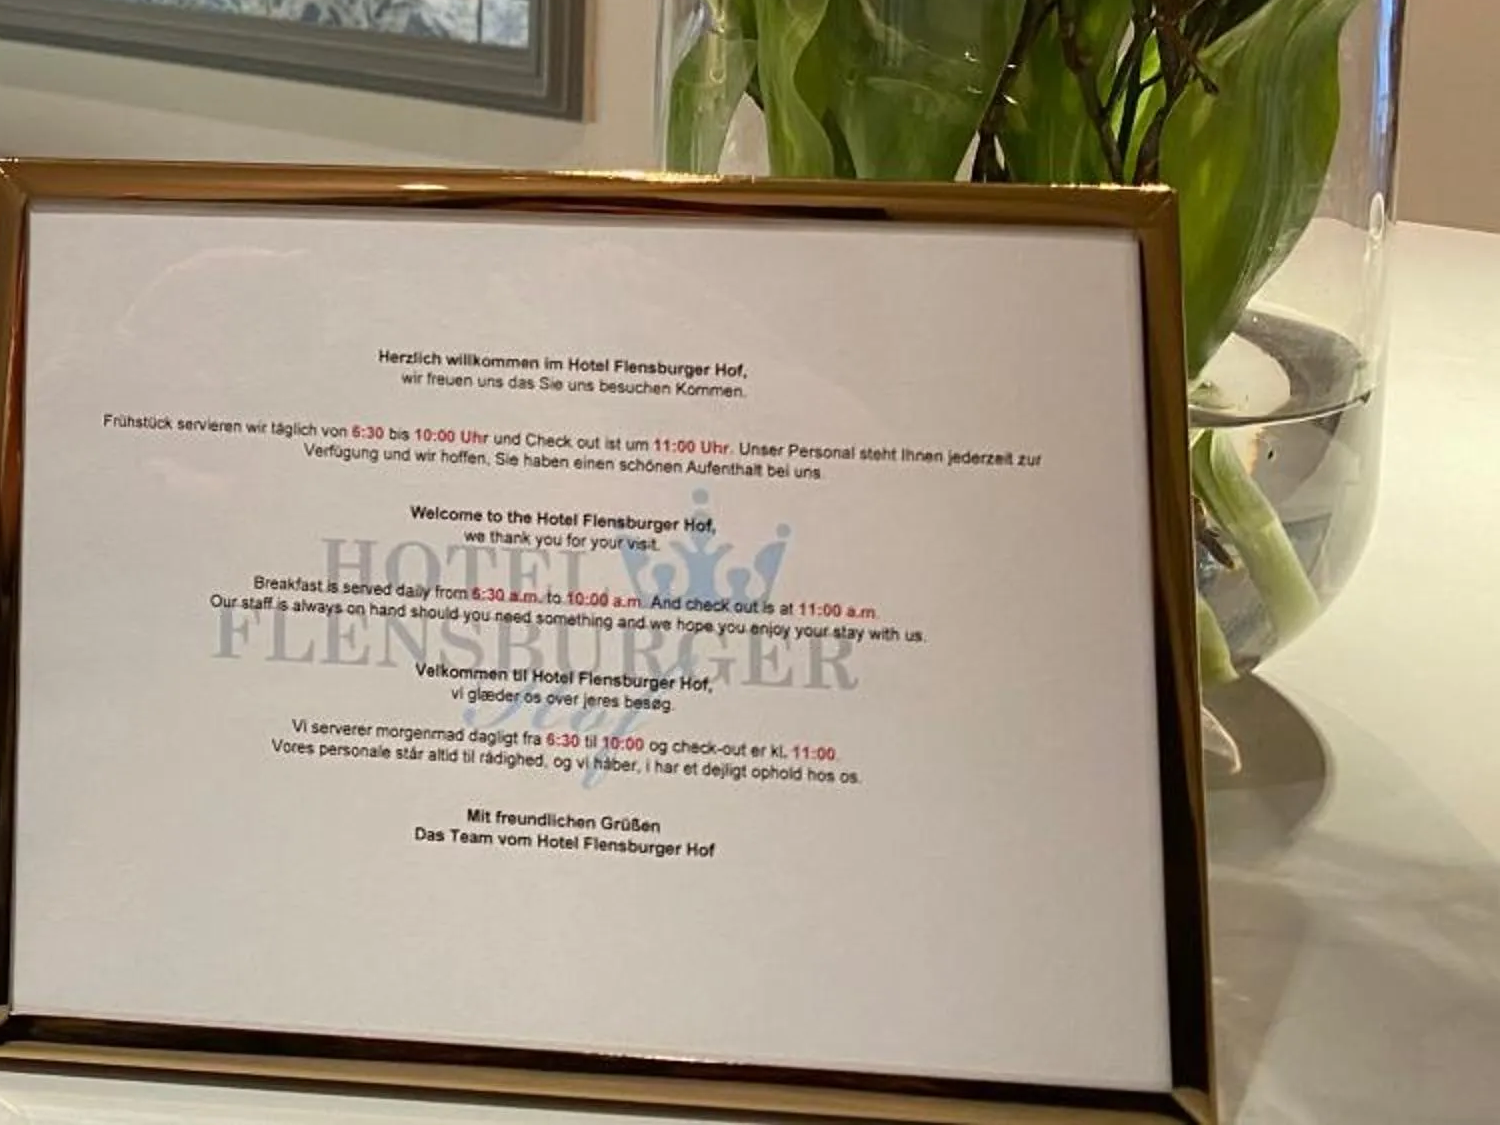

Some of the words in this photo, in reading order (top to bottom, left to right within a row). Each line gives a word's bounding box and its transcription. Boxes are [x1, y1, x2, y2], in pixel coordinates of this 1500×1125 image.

[377, 349, 443, 366] Herzlich
[445, 352, 541, 370] willkommen
[543, 355, 564, 371] im
[567, 356, 610, 373] Hotel
[613, 358, 712, 380] Flensburger
[714, 362, 748, 381] Hof,
[400, 370, 424, 385] wir
[426, 371, 474, 387] freuen
[476, 376, 505, 389] uns
[507, 374, 536, 390] das
[538, 376, 565, 391] Sie
[567, 380, 596, 392] uns
[598, 378, 672, 396] besuchen
[103, 413, 173, 431] Frühstück
[176, 418, 243, 434] servieren
[245, 420, 268, 435] wir
[270, 421, 318, 440] täglich
[320, 426, 349, 438] von
[351, 424, 385, 440] 6:30
[388, 426, 411, 441] bis
[414, 427, 457, 443] 10:00
[459, 429, 490, 444] Uhr
[493, 431, 522, 446] und
[524, 431, 574, 448] Check
[576, 434, 601, 449] out
[604, 435, 622, 450] ist
[624, 439, 650, 451] um
[653, 437, 697, 453] 11:00
[738, 441, 785, 457] Unser
[787, 443, 856, 460] Personal
[859, 446, 898, 462] steht
[900, 448, 944, 464] Ihnen
[947, 450, 1014, 468] jederzeit
[1016, 456, 1042, 468] zur
[303, 443, 380, 465] Verfügung
[382, 447, 412, 462] und
[414, 448, 437, 463] wir
[494, 451, 520, 467] Sie
[523, 452, 570, 469] haben
[572, 455, 615, 471] einen
[618, 457, 683, 474] schönen
[685, 459, 764, 477] Aufenthalt
[766, 463, 791, 478] bei
[409, 504, 484, 522] Welcome
[486, 507, 504, 523] to
[506, 508, 533, 524] the
[535, 510, 580, 526] Hotel
[582, 512, 681, 534] Flensburger
[683, 517, 717, 536] Hof,
[462, 530, 487, 542] we
[488, 528, 532, 545] thank
[534, 533, 564, 549] you
[565, 532, 588, 547] for
[589, 536, 624, 552] your
[321, 538, 610, 601] HOTEL
[252, 574, 325, 592] Breakfast
[326, 578, 340, 593] is
[342, 581, 394, 596] served
[395, 581, 432, 602] daily
[434, 583, 469, 599] from
[470, 585, 506, 601] 6:30
[547, 589, 563, 604] to
[566, 590, 609, 606] 10:00
[650, 594, 683, 610] And
[684, 596, 731, 612] check
[733, 599, 760, 614] out
[762, 599, 776, 615] is
[779, 601, 795, 615] at
[798, 601, 843, 618] 11:00
[209, 593, 238, 609] Our
[241, 595, 273, 611] staff
[275, 597, 289, 612] is
[291, 598, 344, 618] always
[346, 603, 366, 615] on
[369, 601, 407, 617] hand
[410, 604, 460, 620] should
[463, 609, 491, 625] you
[494, 609, 533, 624] need
[535, 611, 613, 632] something
[616, 614, 647, 629] and
[649, 618, 672, 630] we
[676, 616, 715, 636] hope
[717, 621, 747, 637] you
[749, 621, 791, 640] enjoy
[794, 625, 829, 641] your
[832, 624, 865, 644] stay
[868, 626, 900, 642] with
[904, 630, 928, 643] us.
[210, 606, 859, 690] FLENSBURGER
[414, 662, 509, 681] Velkommen
[511, 667, 529, 682] til
[531, 668, 575, 685] Hotel
[577, 670, 677, 693] Flensburger
[679, 676, 713, 695] Hof,
[451, 685, 464, 700] vi
[467, 686, 521, 705] glæder
[523, 692, 543, 704] os
[545, 693, 580, 706] over
[583, 692, 620, 711] jeres
[290, 718, 309, 734] Vi
[310, 722, 373, 737] serverer
[375, 726, 466, 743] morgenmad
[467, 728, 519, 748] dagligt
[522, 731, 543, 746] fra
[545, 732, 581, 748] 6:30
[584, 734, 599, 749] til
[602, 735, 646, 752] 10:00
[648, 740, 669, 757] og
[750, 746, 767, 758] er
[271, 738, 316, 755] Vores
[318, 744, 392, 760] personale
[395, 745, 425, 761] står
[427, 747, 459, 763] altid
[461, 748, 476, 763] til
[552, 756, 573, 773] og
[575, 755, 591, 770] vi
[654, 759, 680, 774] har
[682, 760, 699, 775] et
[701, 761, 748, 782] dejligt
[750, 765, 803, 783] ophold
[806, 767, 836, 783] hos
[466, 807, 492, 823] Mit
[495, 809, 597, 829] freundlichen
[600, 815, 661, 833] Grüßen
[413, 826, 446, 842] Das
[449, 828, 495, 845] Team
[496, 834, 534, 847] vom
[536, 833, 580, 850] Hotel
[582, 836, 683, 859] Flensburger
[685, 842, 717, 858] Hof
